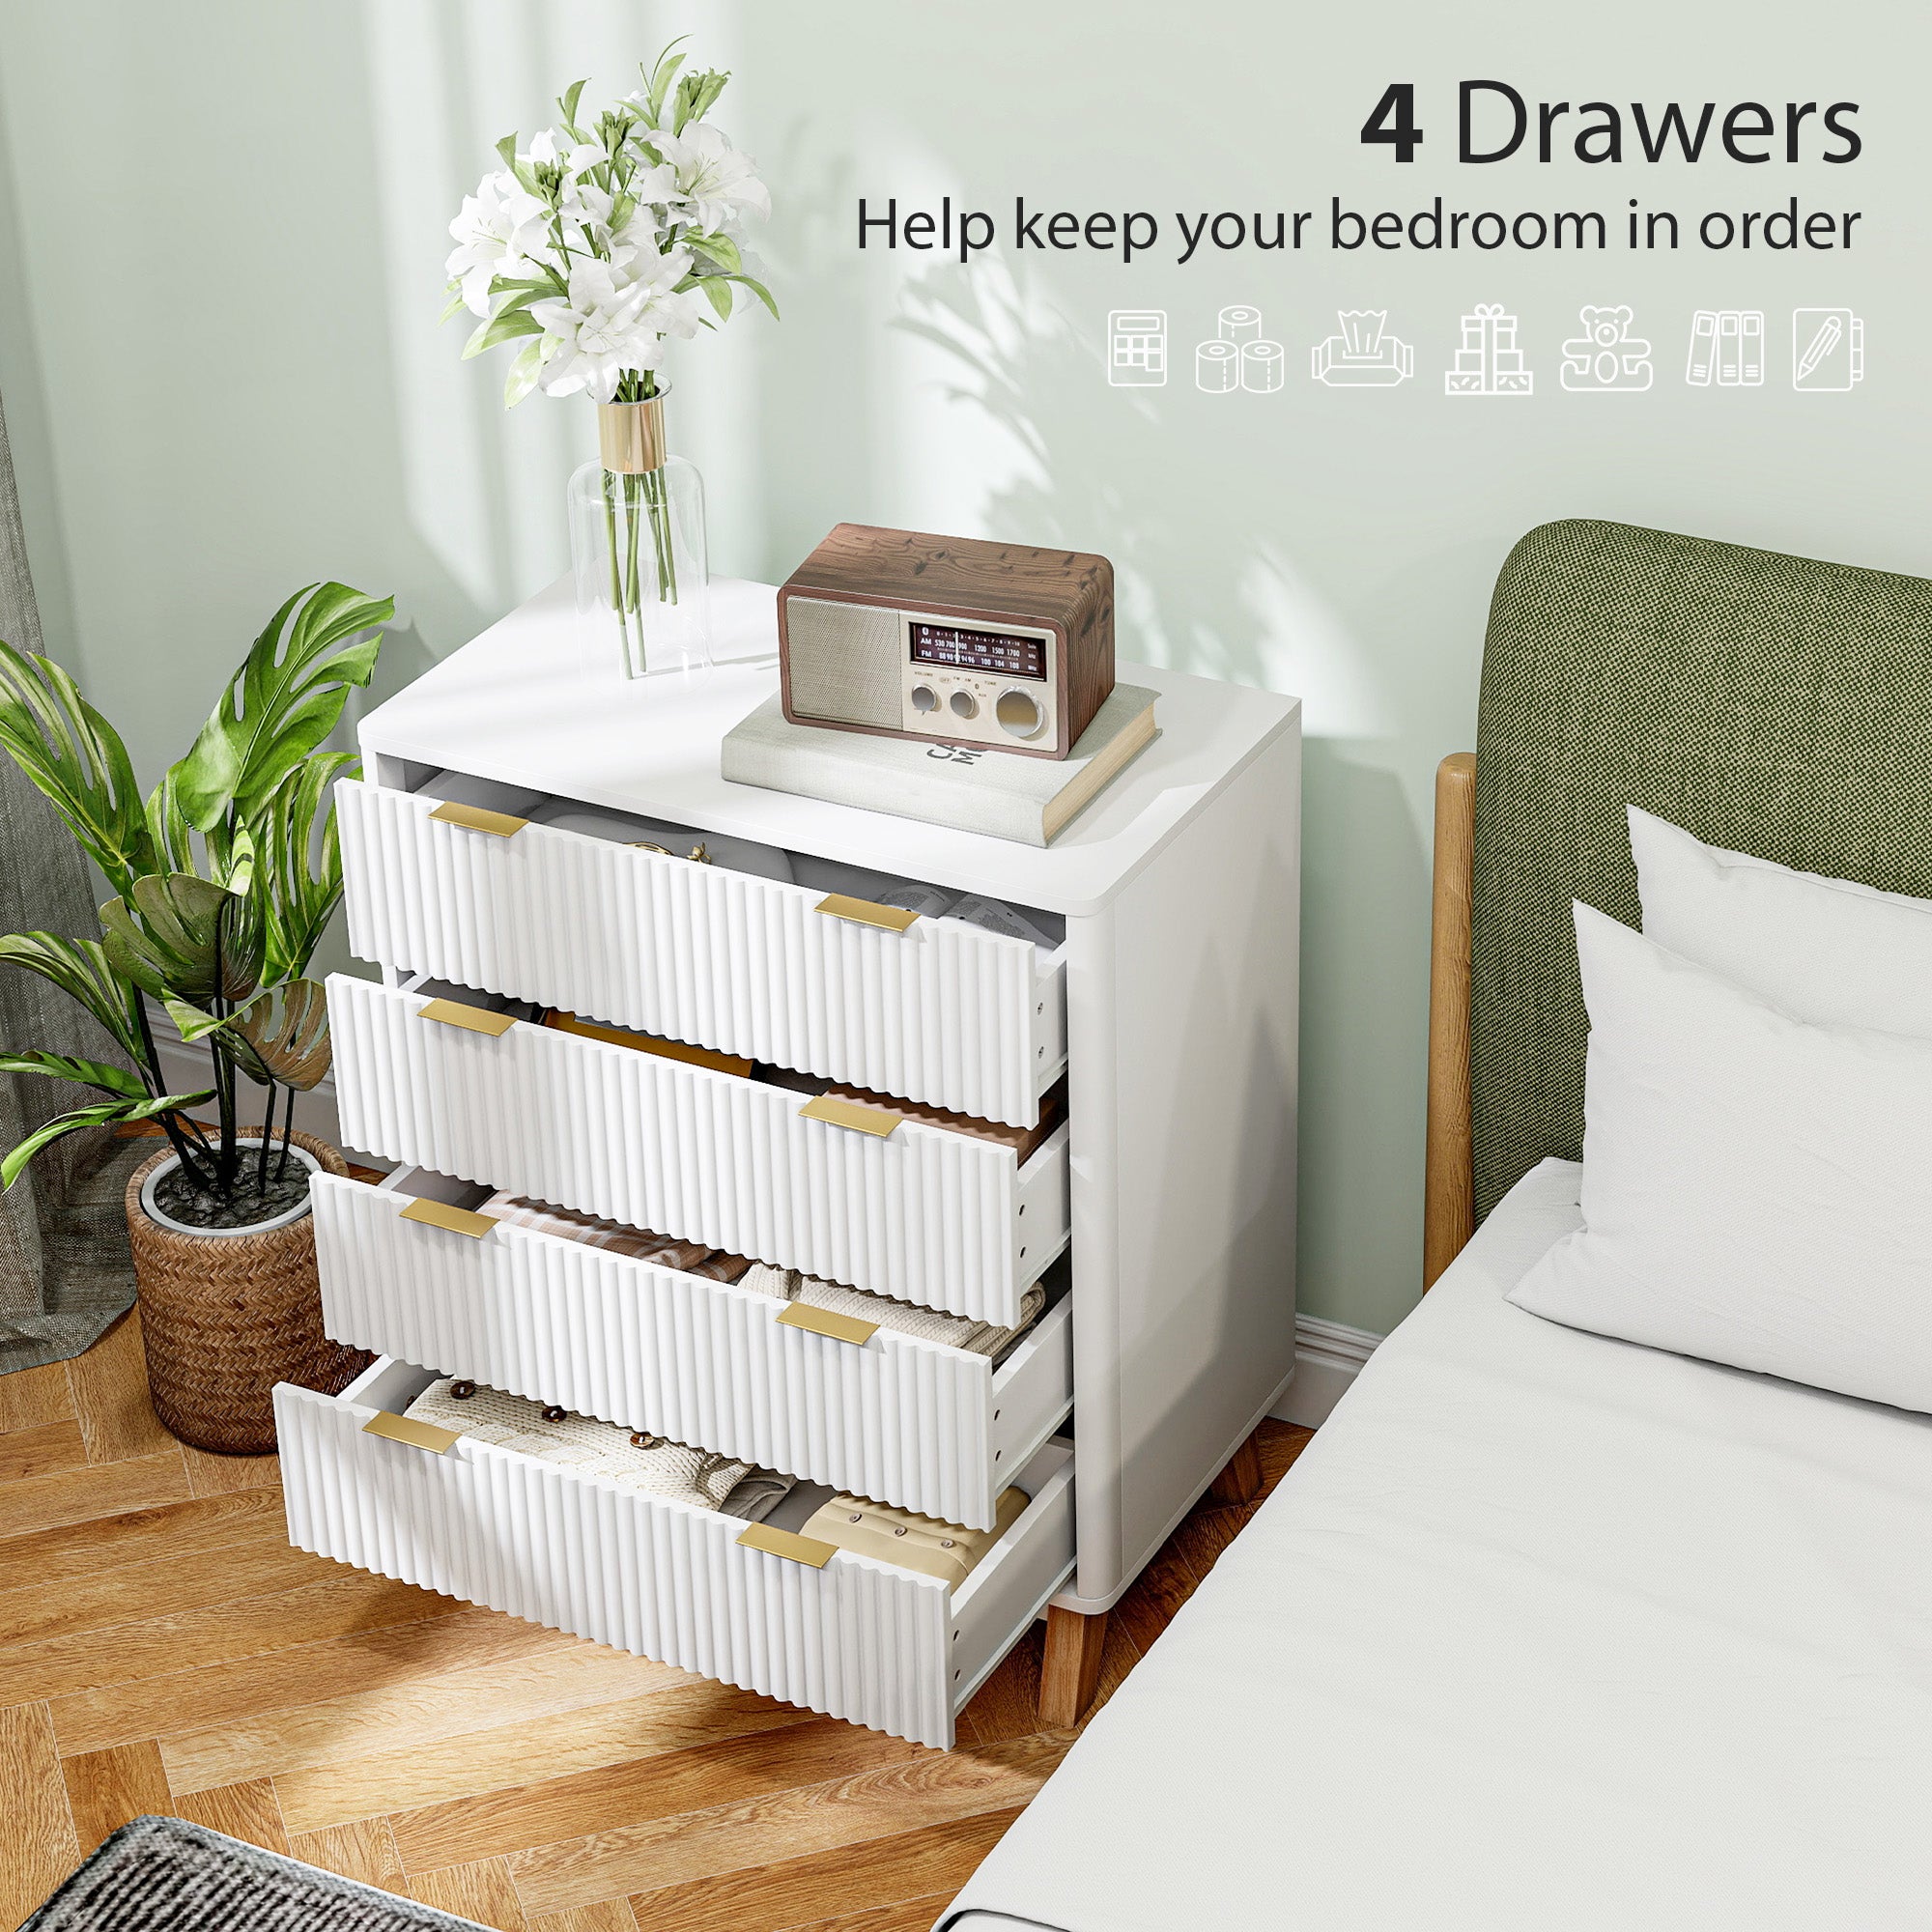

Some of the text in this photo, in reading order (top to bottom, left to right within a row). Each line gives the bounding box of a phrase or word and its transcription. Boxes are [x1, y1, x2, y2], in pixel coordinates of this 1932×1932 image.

[920, 637, 932, 645] AM
[934, 639, 945, 647] 530
[946, 640, 955, 648] 700
[974, 644, 987, 653] 1200
[992, 646, 1004, 655] 1500
[1007, 648, 1020, 657] 1700
[981, 657, 991, 666] 100
[994, 659, 1004, 667] 104
[951, 748, 988, 765] M
